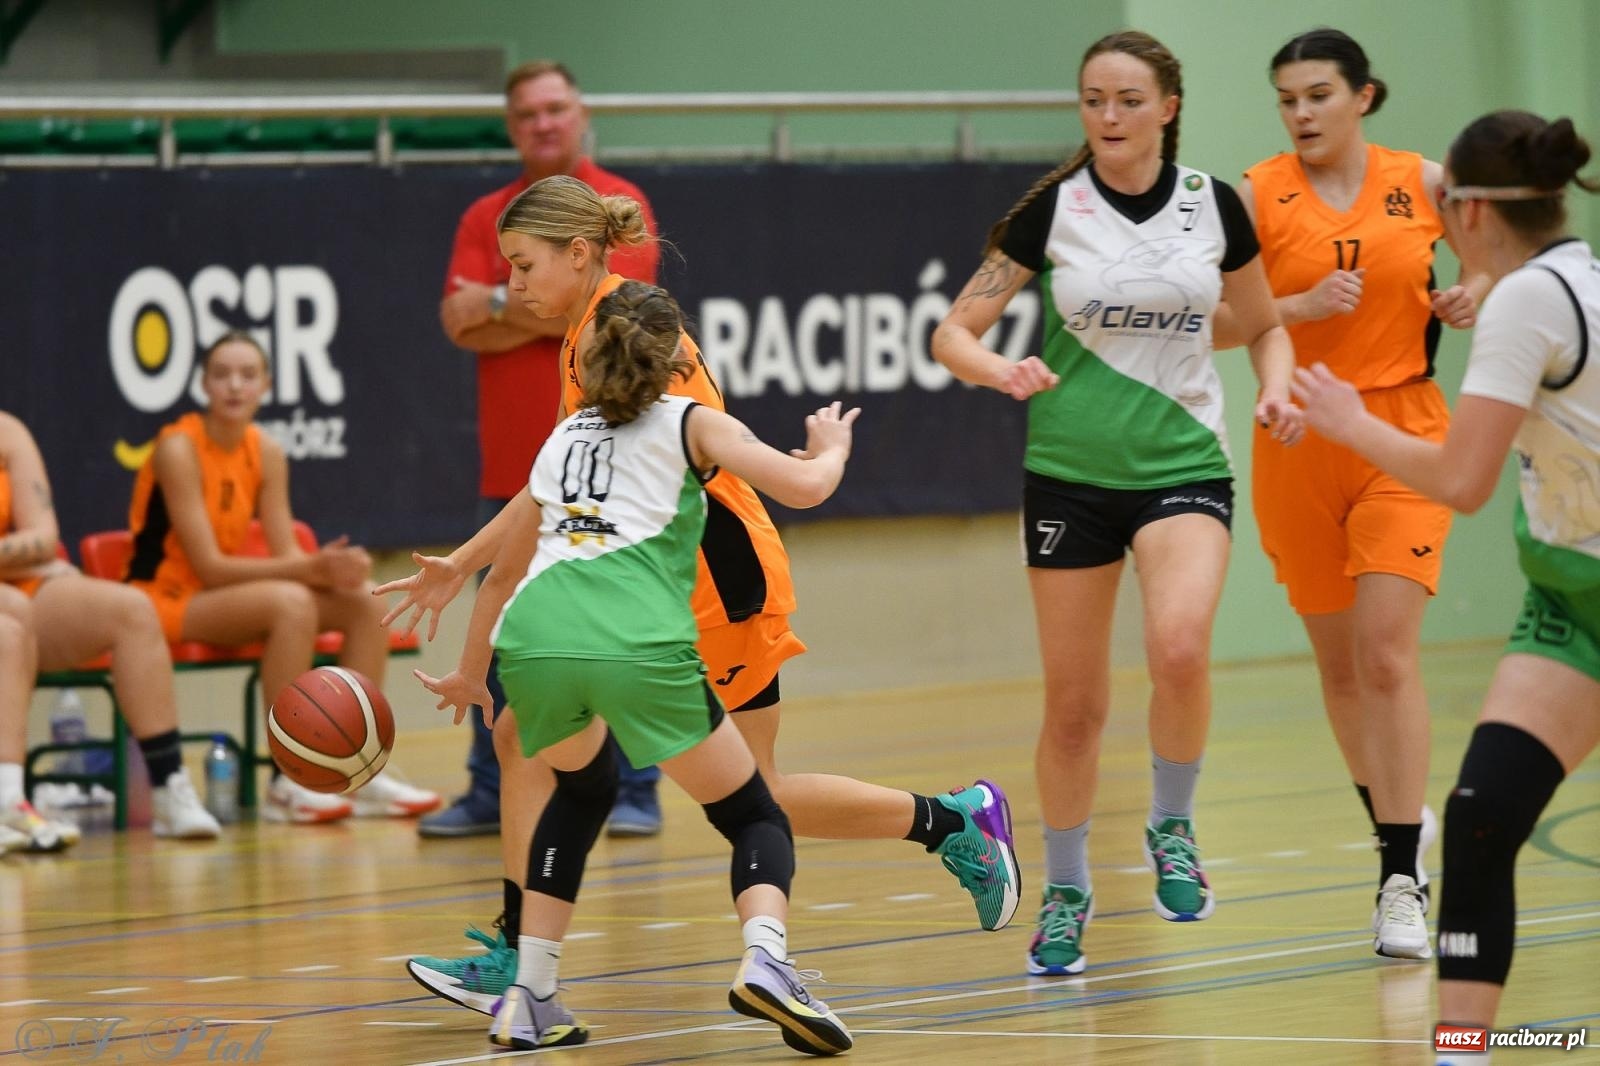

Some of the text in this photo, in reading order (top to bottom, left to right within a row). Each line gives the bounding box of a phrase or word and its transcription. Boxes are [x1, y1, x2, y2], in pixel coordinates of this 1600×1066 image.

[1178, 201, 1201, 232] 7
[1333, 238, 1361, 270] 17
[700, 258, 1041, 398] RACIBÓZ
[1101, 304, 1206, 333] Clavis
[1035, 519, 1067, 555] 7
